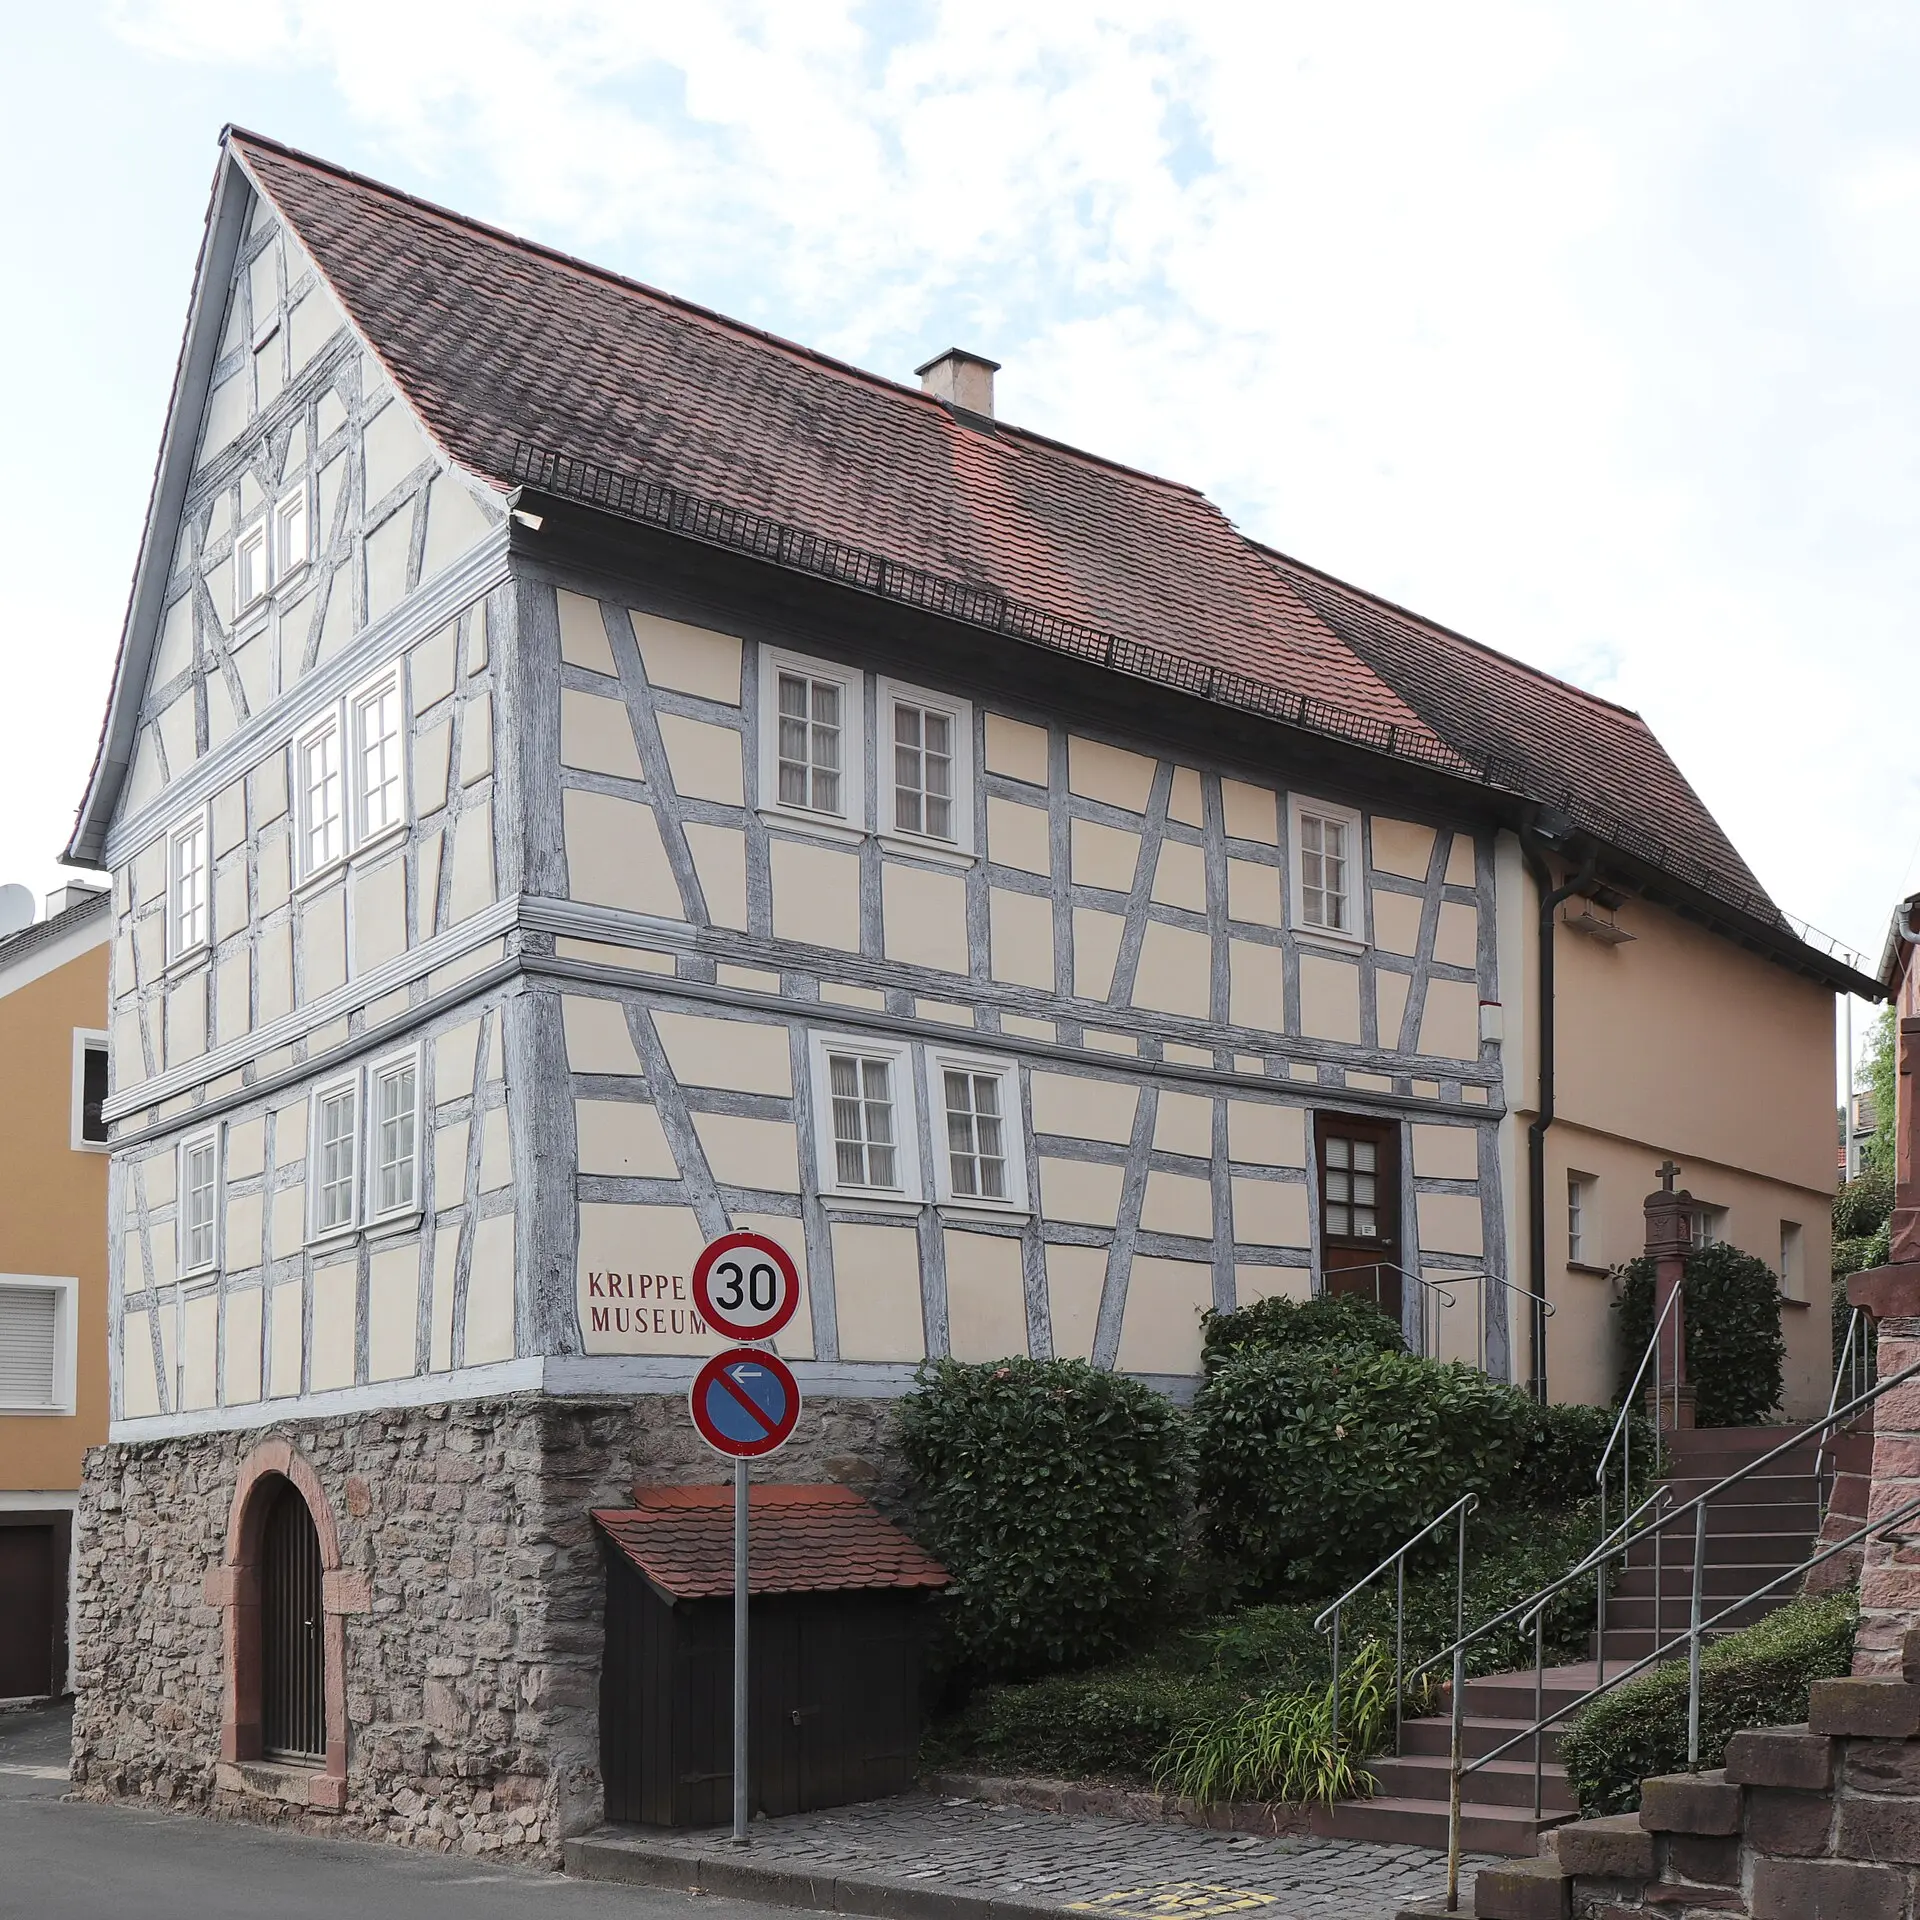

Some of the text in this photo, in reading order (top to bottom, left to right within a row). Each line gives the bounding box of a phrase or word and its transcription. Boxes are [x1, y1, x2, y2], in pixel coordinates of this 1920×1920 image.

[588, 1272, 686, 1300] KRIPPE
[716, 1262, 776, 1311] 30
[591, 1306, 707, 1335] MUSEUM
